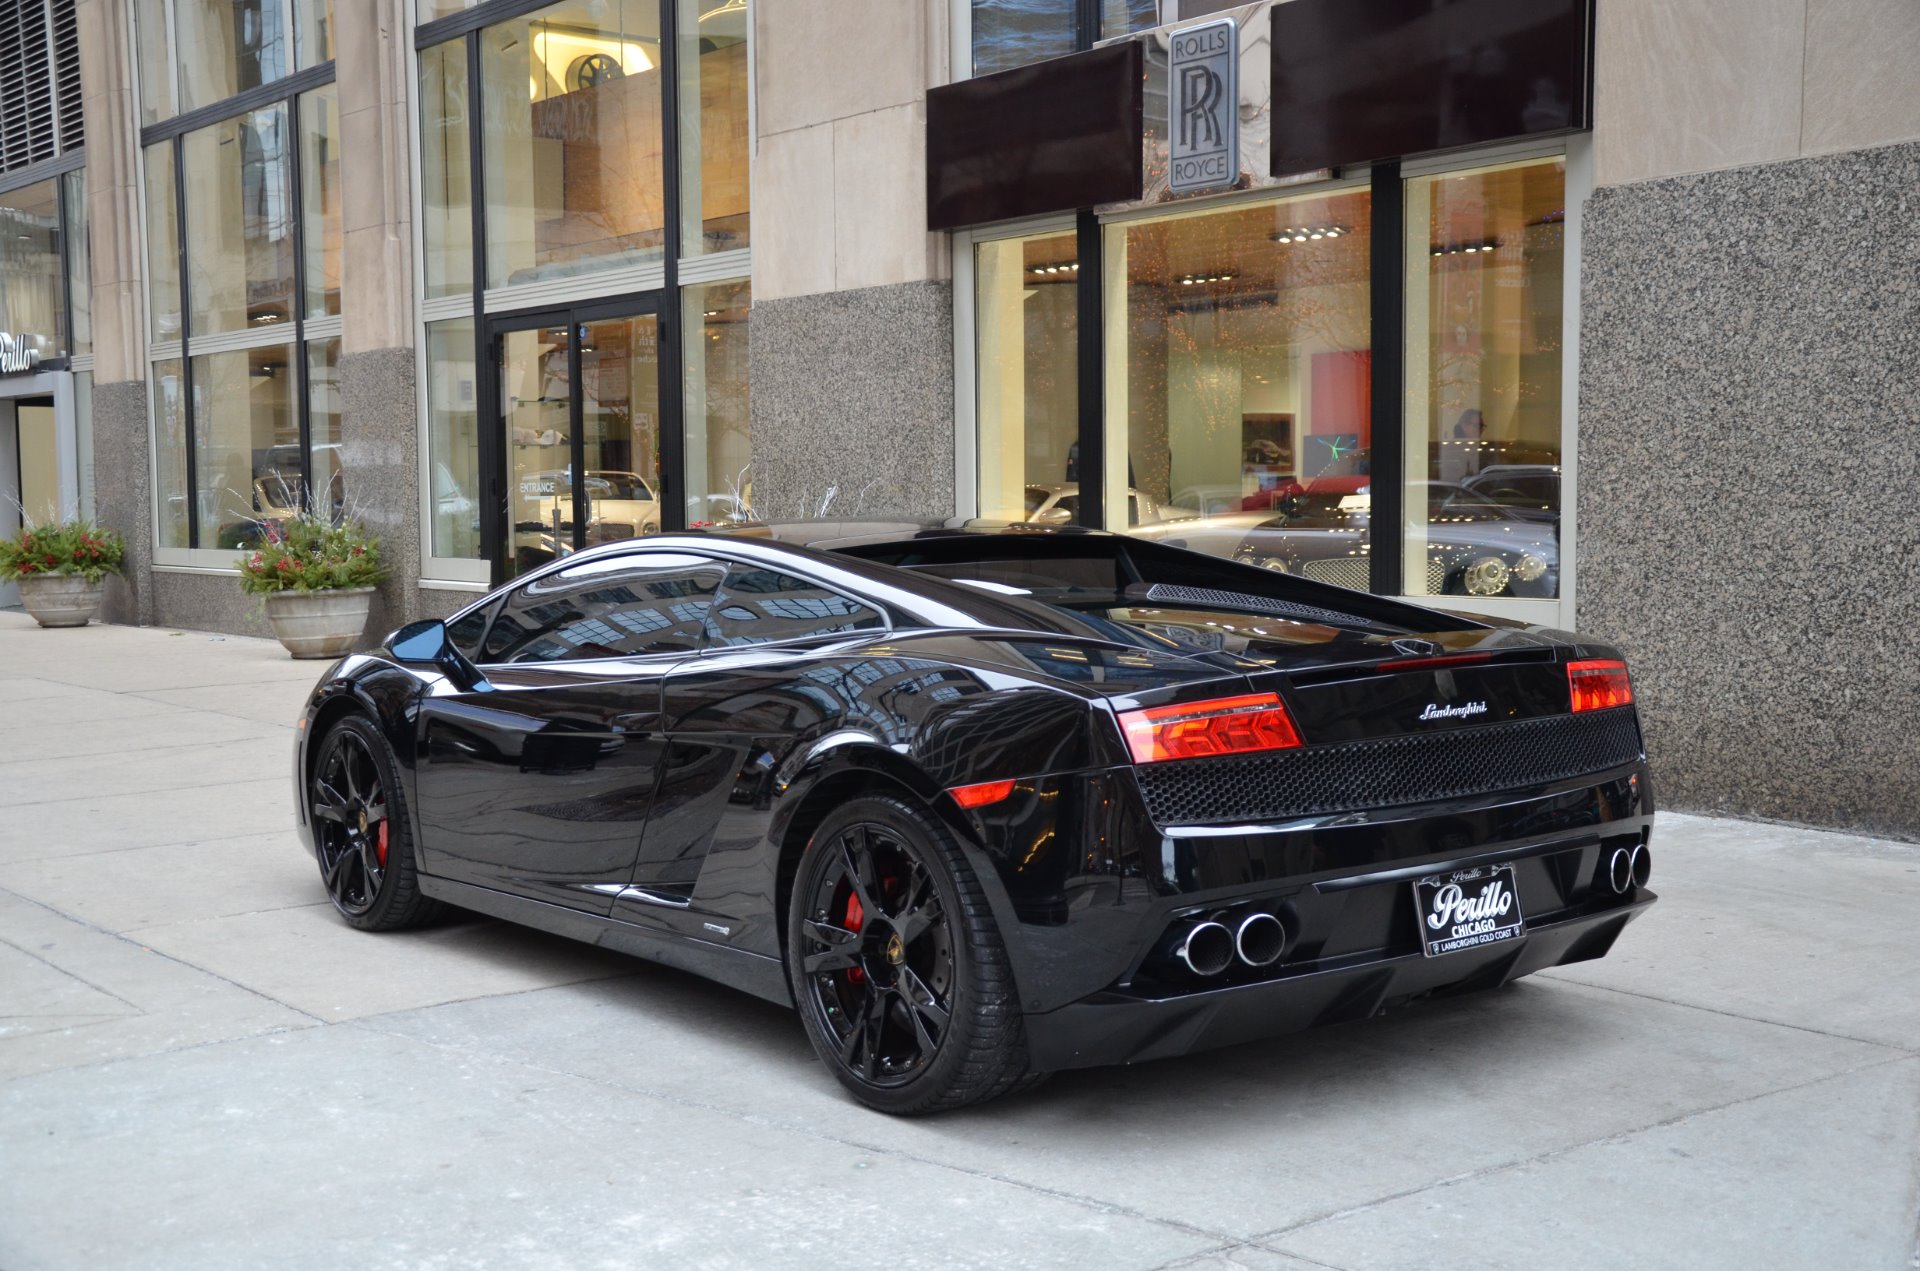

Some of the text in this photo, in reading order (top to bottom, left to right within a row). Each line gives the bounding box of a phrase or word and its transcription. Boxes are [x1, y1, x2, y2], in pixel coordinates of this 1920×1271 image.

[1175, 31, 1225, 59] ROLLS
[1175, 156, 1225, 181] ROYCE
[520, 482, 555, 493] ENTRANCE
[1419, 701, 1487, 720] Lamborghini
[1450, 868, 1481, 883] Perillo
[1427, 881, 1512, 929] Perillo
[1451, 918, 1496, 938] CHICAGO
[1441, 929, 1511, 951] LAMBORGHINI GOLD COAST
